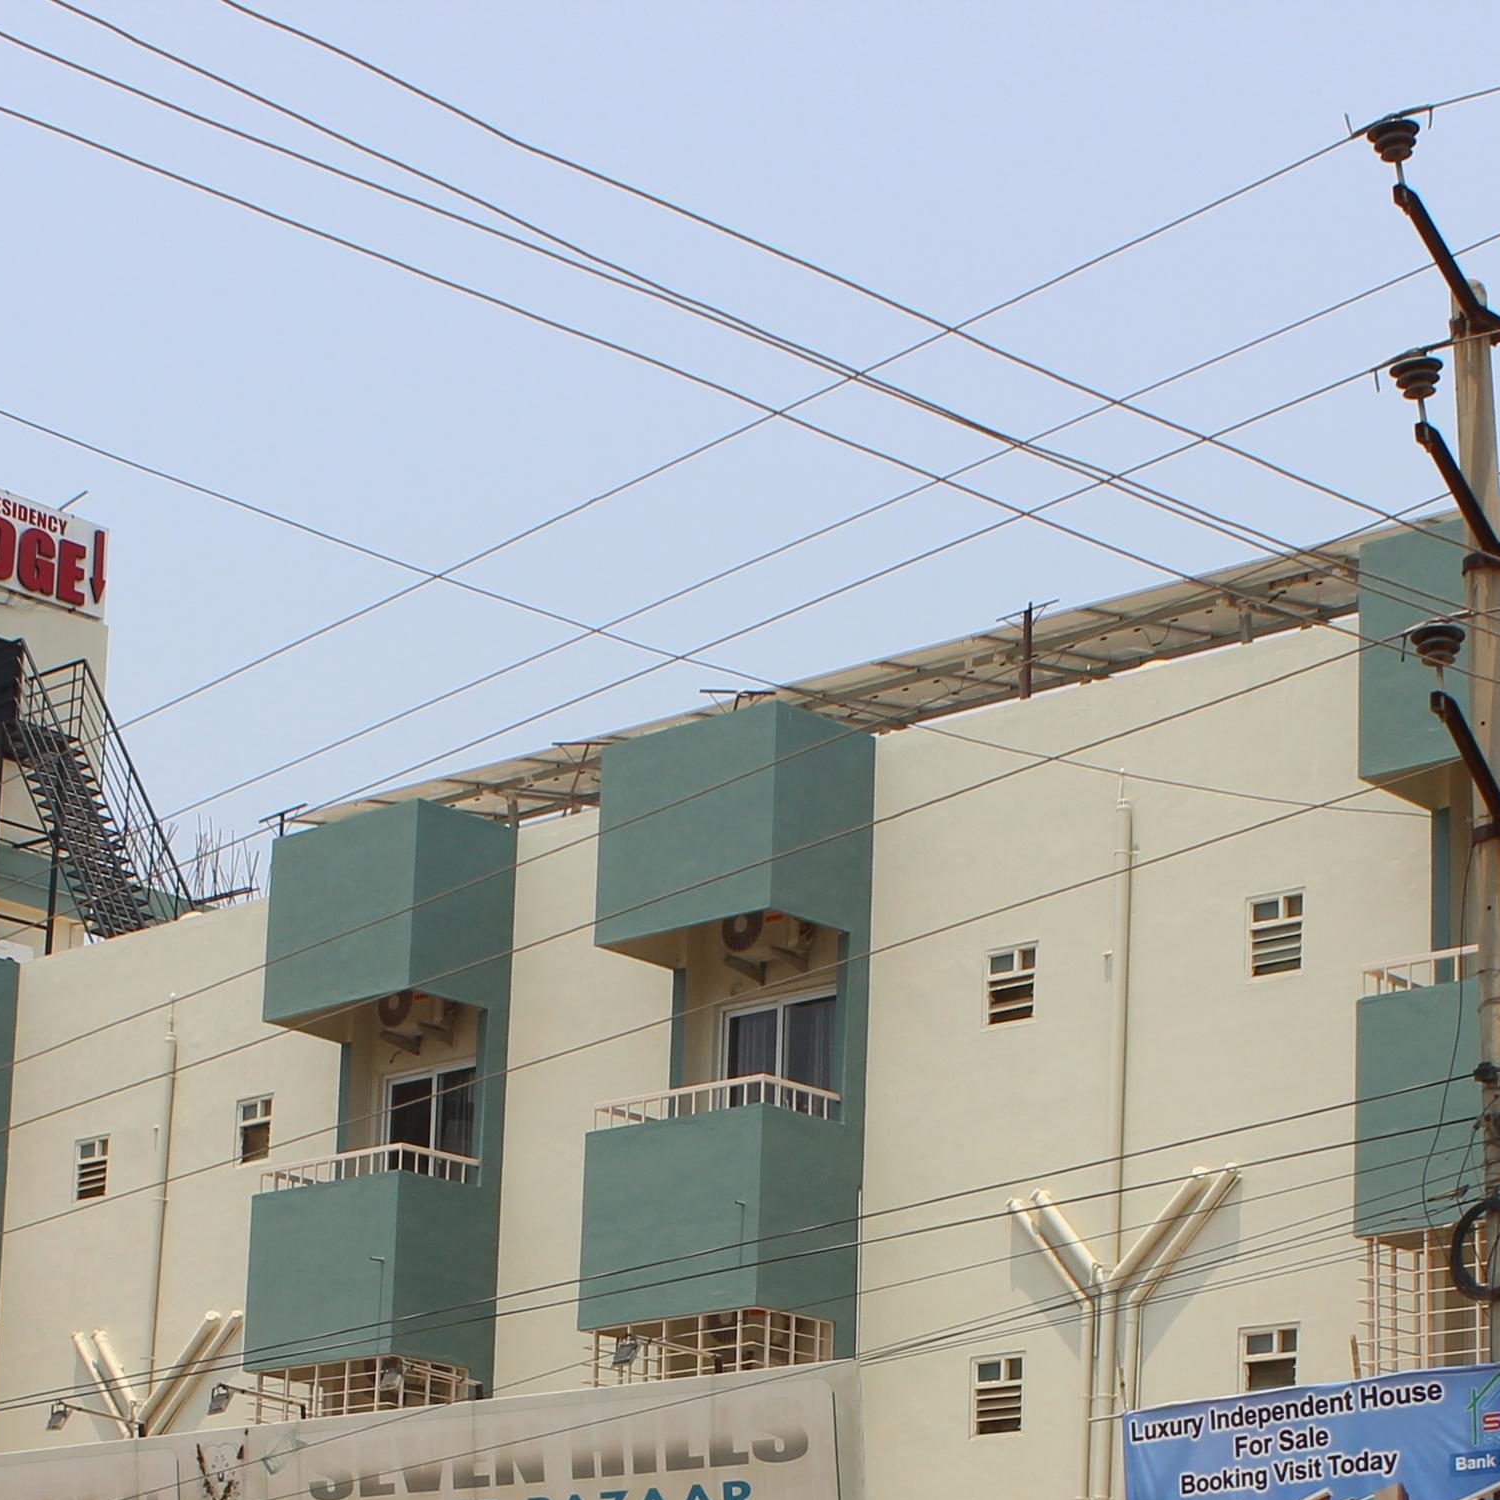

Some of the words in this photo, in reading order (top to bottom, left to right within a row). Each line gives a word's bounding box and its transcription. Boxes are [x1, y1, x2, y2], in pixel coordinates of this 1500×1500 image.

[1130, 1415, 1205, 1443] Luxury
[1210, 1389, 1354, 1431] Independent
[1360, 1381, 1445, 1409] House
[1234, 1436, 1273, 1458] For
[1279, 1426, 1329, 1452] Sale
[1180, 1469, 1268, 1496] Booking
[1273, 1458, 1323, 1484] Visit
[1327, 1451, 1398, 1477] Today
[1455, 1454, 1496, 1471] Bank
